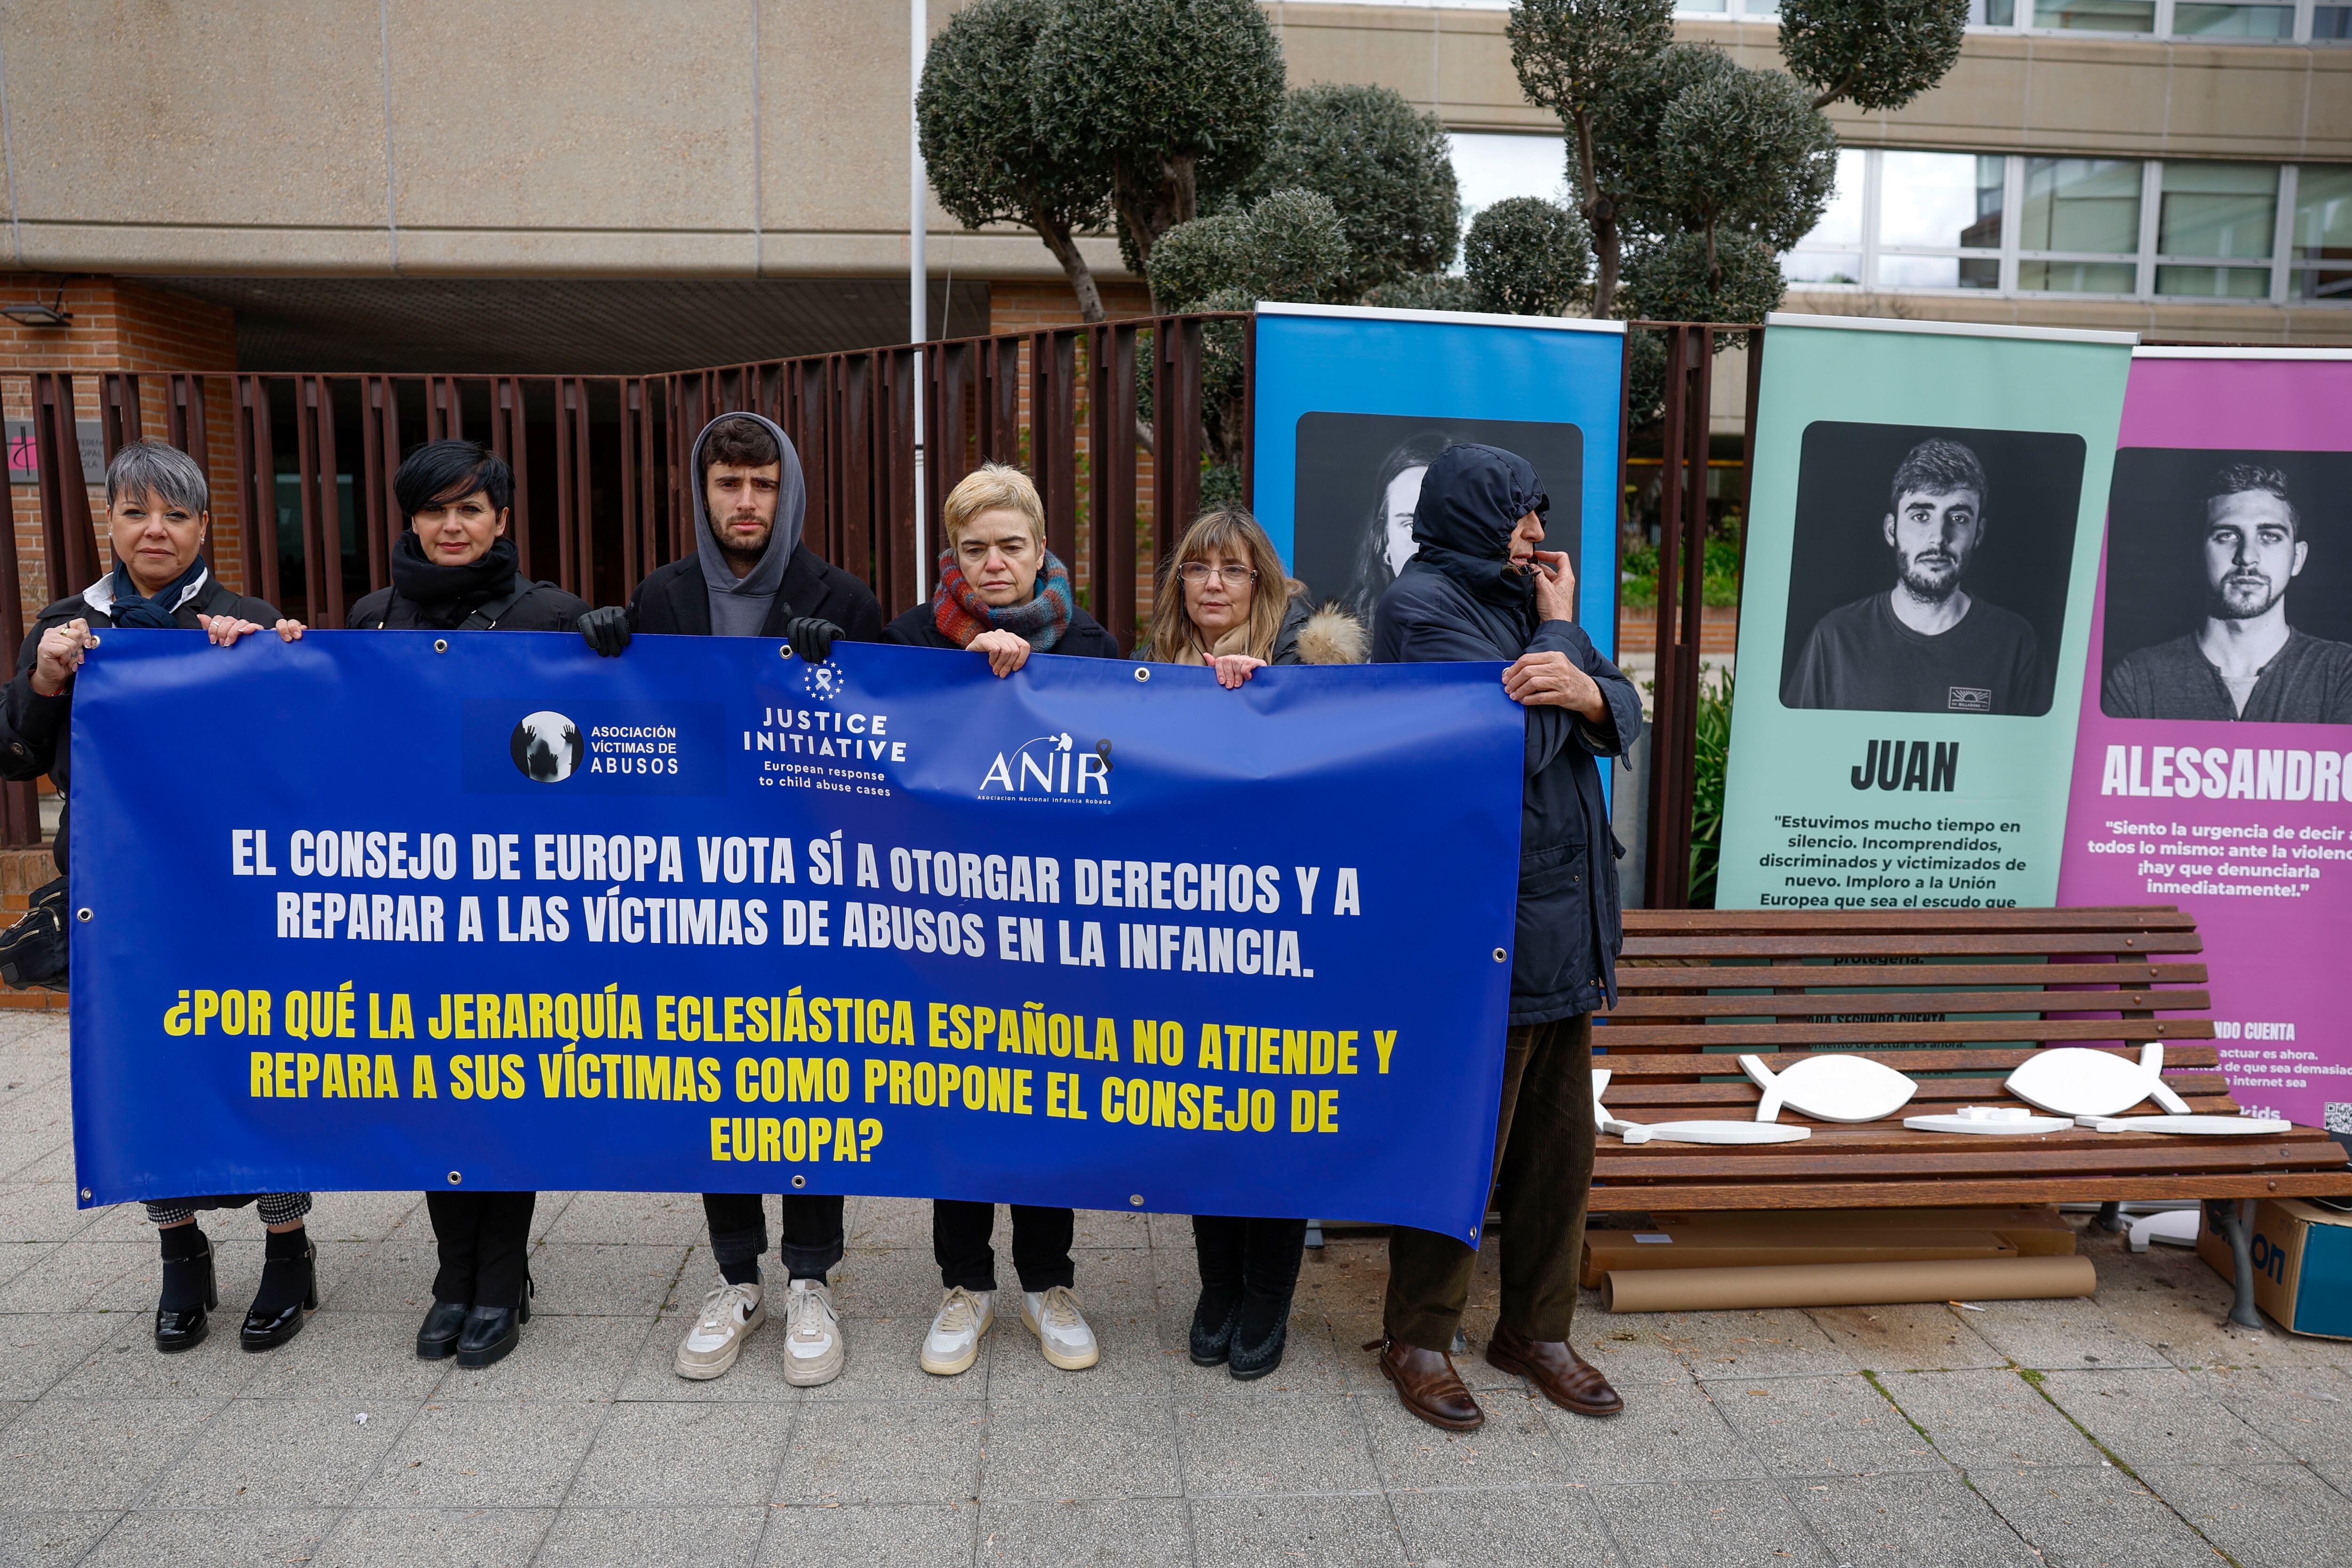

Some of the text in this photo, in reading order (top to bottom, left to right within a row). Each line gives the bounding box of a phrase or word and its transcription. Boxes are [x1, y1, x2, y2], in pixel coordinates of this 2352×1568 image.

[763, 708, 887, 735] JUSTICE
[592, 725, 675, 738] ASOCIACIÓN
[592, 740, 676, 753] VÍCTIMAS DE
[744, 732, 906, 762] INITIATIVE
[591, 757, 677, 774] ABUSOS
[765, 761, 884, 780] European response
[979, 751, 1108, 795] ANIR
[1851, 739, 1959, 791] JUAN
[759, 776, 890, 796] to child abuse cases
[1775, 816, 2020, 834] "Estuvimos mucho tiempo en
[2106, 820, 2167, 835] "Siento
[2171, 822, 2187, 836] la
[2192, 824, 2268, 840] urgencia
[2273, 825, 2295, 839] de
[2299, 826, 2345, 840] decir
[1788, 835, 2001, 853] silencio. Incomprendidos,
[2087, 840, 2135, 854] todos
[2139, 841, 2155, 854] lo
[2160, 841, 2225, 856] mismo:
[2228, 845, 2267, 858] ante
[2272, 844, 2287, 858] la
[1760, 854, 2026, 871] discriminados y victimizados de
[2138, 860, 2320, 878] ¡hay que denunciarla
[232, 829, 1360, 915] EL CONSEJO DE EUROPA VOTA SÍ A OTORGAR DERECHOS Y A
[1786, 876, 1995, 890] nuevo. Imploro a la Unión
[1761, 894, 1828, 908] Europea
[1835, 898, 1866, 909] que
[1871, 898, 1897, 907] sea
[1903, 895, 1917, 907] el
[1923, 896, 1981, 908] escudo
[278, 885, 1313, 977] REPARAR A LAS VÍCTIMAS DE ABUSOS EN LA INFANCIA.
[164, 980, 1397, 1074] ¿POR QUÉ LA JERARQUÍA ECLESIÁSTICA ESPAÑOLA NO ATIENDE Y
[2244, 1022, 2295, 1040] CUENTA
[2220, 1049, 2260, 1058] actuar
[2280, 1050, 2318, 1060] ahora.
[2225, 1062, 2241, 1072] de
[2243, 1065, 2267, 1074] que
[251, 1043, 1338, 1132] REPARA A SUS VÍCTIMAS COMO PROPONE EL CONSEJO DE
[2233, 1075, 2283, 1087] internet
[711, 1118, 882, 1162] EUROPA?
